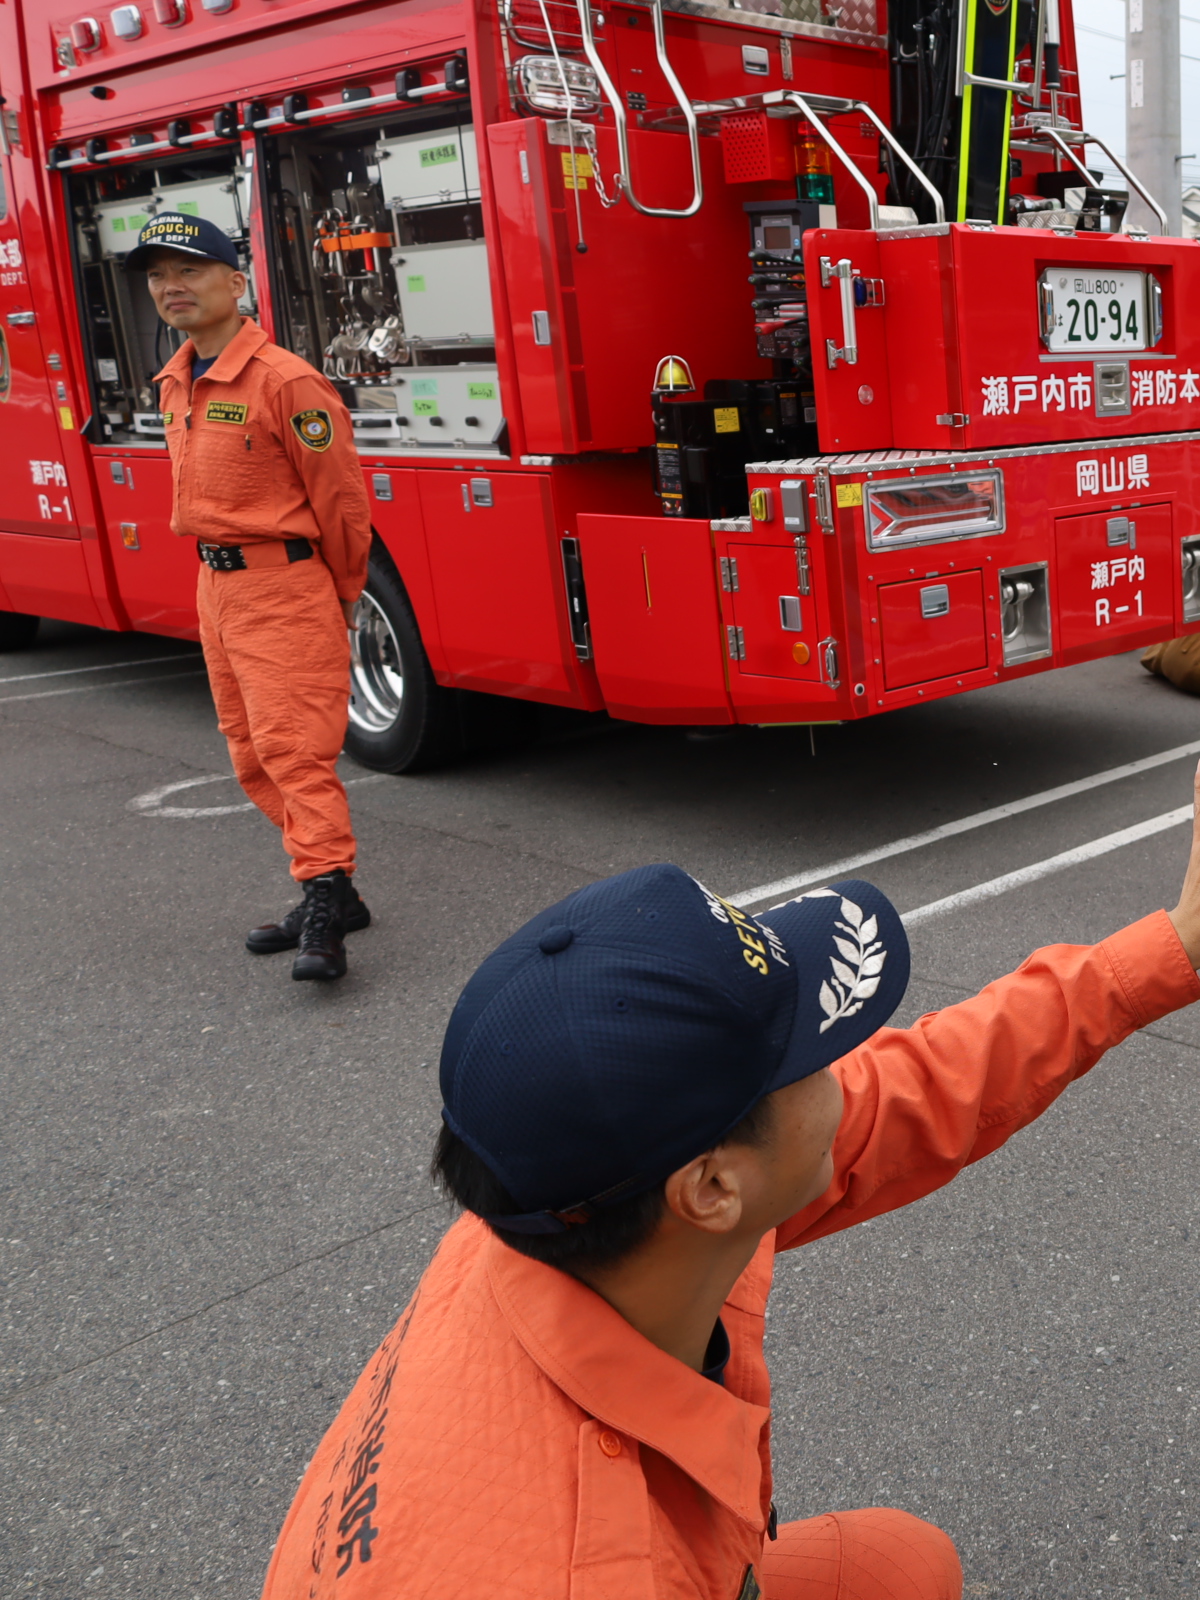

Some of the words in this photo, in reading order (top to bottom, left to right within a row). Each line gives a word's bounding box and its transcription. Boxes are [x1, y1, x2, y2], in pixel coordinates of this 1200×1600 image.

[140, 223, 199, 242] SETOUCHI
[165, 234, 191, 244] DEPT
[981, 372, 1093, 416] 瀬戸内市
[29, 459, 69, 487] 瀬戸内
[1076, 453, 1150, 497] 岡山県
[38, 493, 73, 522] R-1
[1090, 554, 1146, 590] 瀬戸内
[1094, 589, 1143, 627] R-1
[713, 892, 769, 975] SETO
